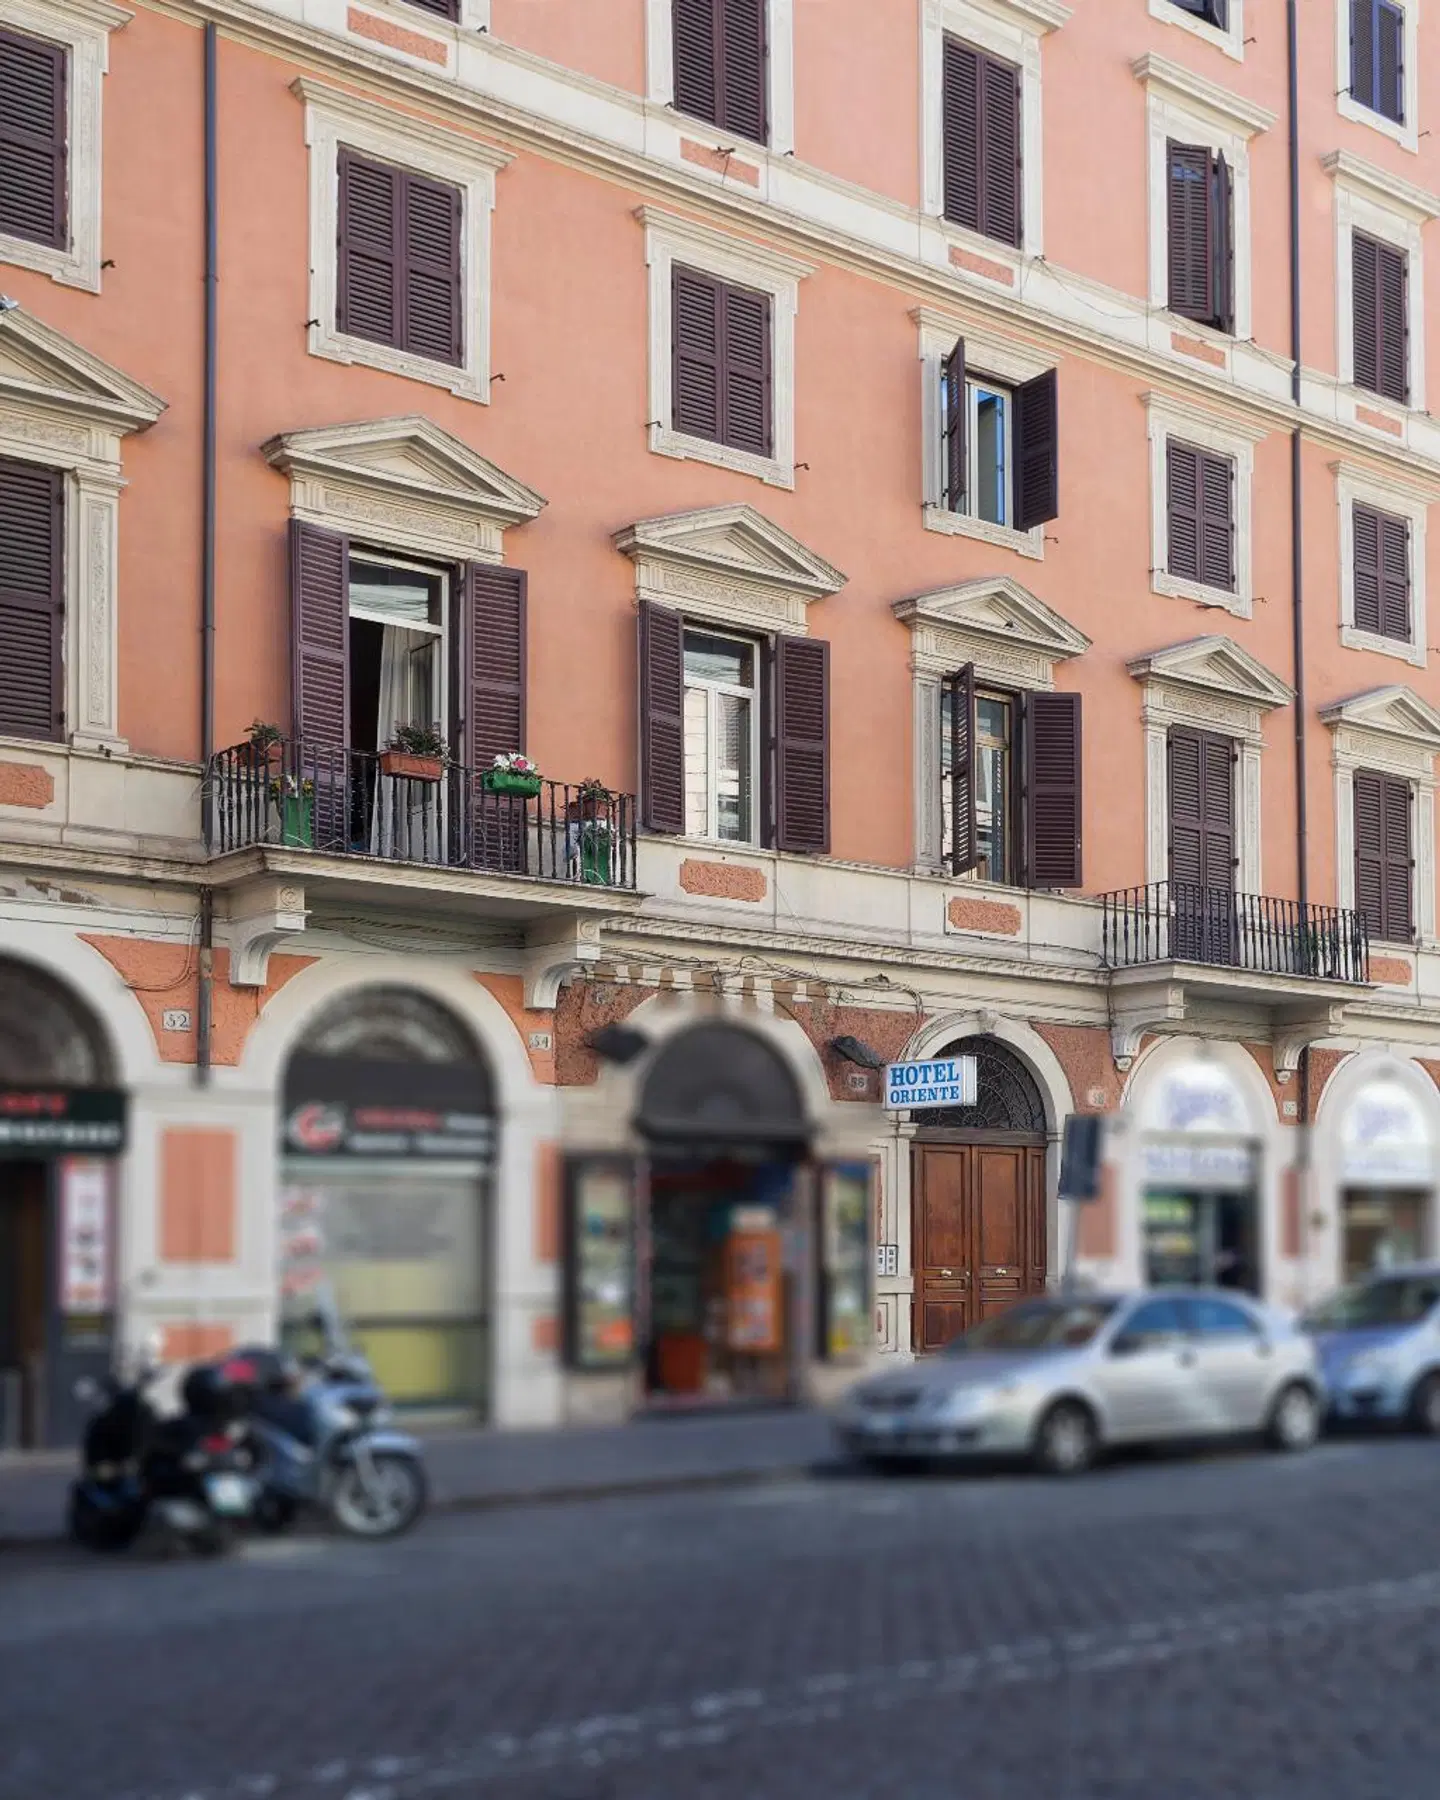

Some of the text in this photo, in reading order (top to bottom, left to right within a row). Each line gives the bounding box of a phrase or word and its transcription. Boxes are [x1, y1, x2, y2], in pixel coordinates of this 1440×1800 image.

[166, 1013, 189, 1028] 52
[890, 1062, 959, 1087] HOTEL
[890, 1085, 959, 1104] ORIENTE
